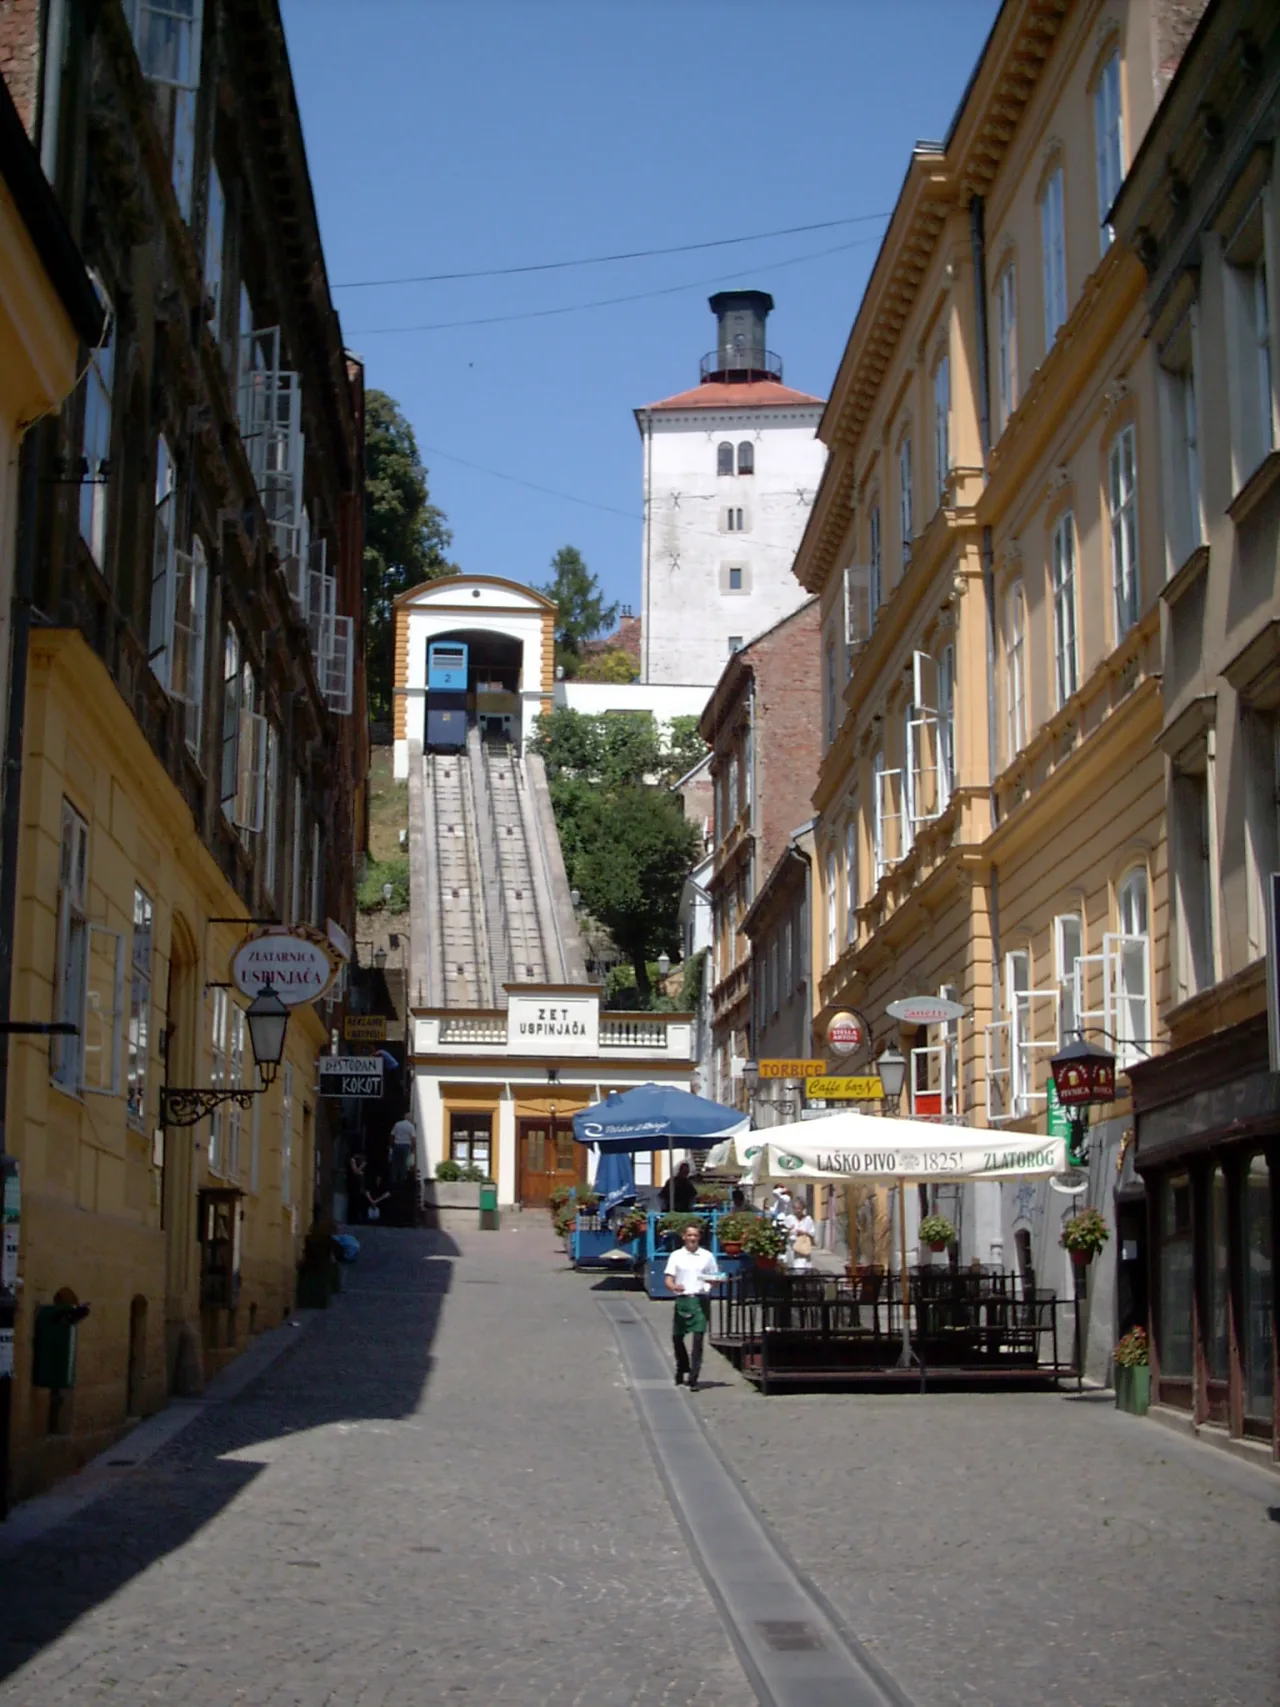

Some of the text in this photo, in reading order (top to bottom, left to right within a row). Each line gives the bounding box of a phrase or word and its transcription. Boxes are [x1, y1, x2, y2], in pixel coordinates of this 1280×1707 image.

[444, 673, 452, 683] 2
[248, 951, 316, 962] ZLATARNICA
[538, 1008, 569, 1021] ZET
[520, 1021, 586, 1036] USPINJAČA
[761, 1064, 823, 1077] TORBICE
[342, 1076, 381, 1094] KOKOT
[808, 1079, 841, 1095] Caffe
[816, 1149, 1055, 1172] LAŠKO PIVO 1825! ZLATOROG
